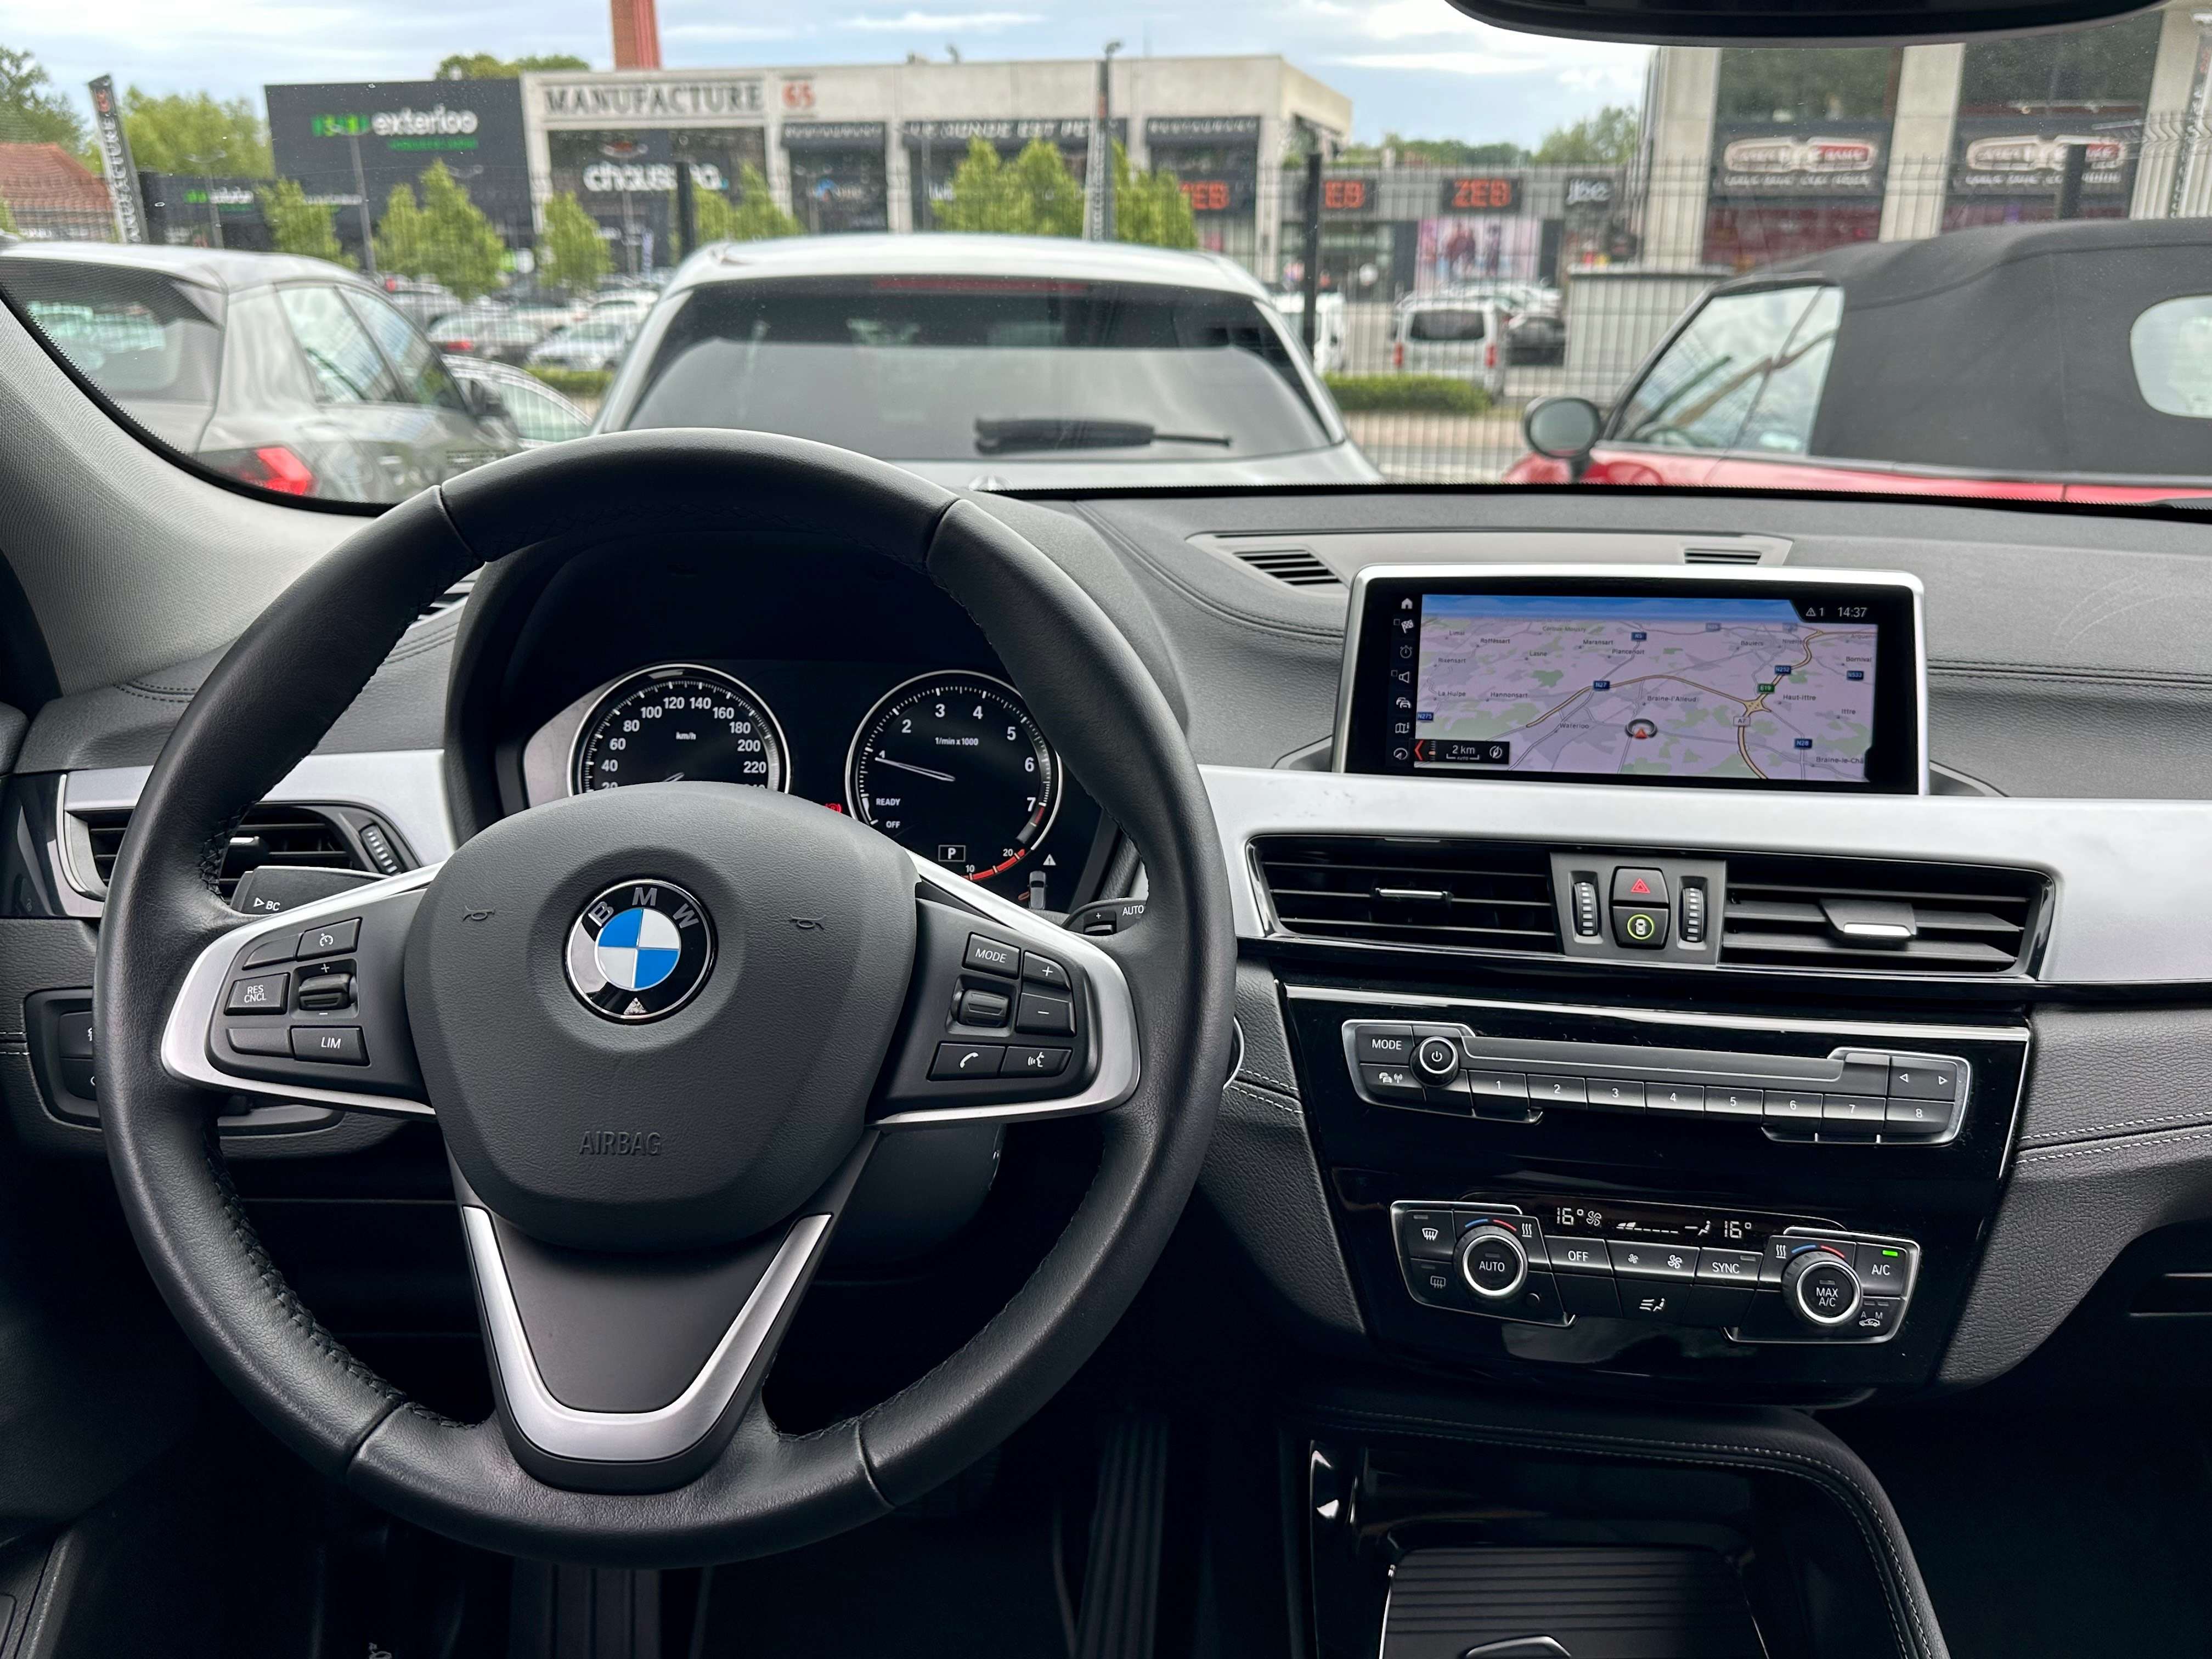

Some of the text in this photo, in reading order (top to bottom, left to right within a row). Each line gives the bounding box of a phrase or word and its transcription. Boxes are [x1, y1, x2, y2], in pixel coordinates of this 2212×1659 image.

[548, 84, 761, 112] MANUFACTURE
[782, 81, 815, 109] 65
[1452, 178, 1511, 208] ZEB
[1819, 607, 1824, 617] 1
[1838, 607, 1867, 618] 14:37
[663, 697, 685, 709] 120
[690, 697, 712, 709] 140
[640, 706, 662, 719] 100
[713, 707, 735, 719] 160
[935, 704, 945, 718] 3
[973, 706, 983, 719] 4
[623, 720, 640, 732] 80
[729, 721, 751, 734] 180
[901, 719, 912, 733] 2
[675, 731, 697, 741] km/h
[1006, 726, 1017, 741] 5
[610, 737, 627, 751] 60
[737, 740, 761, 752] 200
[935, 737, 955, 746] 1/min
[961, 737, 979, 746] 1000
[1452, 744, 1475, 754] 2 km
[601, 759, 618, 772] 40
[743, 761, 766, 774] 220
[1024, 757, 1035, 772] 6
[876, 798, 901, 806] READY
[1026, 797, 1036, 812] 7
[947, 848, 957, 860] P
[1002, 848, 1013, 857] 20
[966, 865, 975, 873] 10
[265, 900, 281, 912] BC
[588, 887, 700, 929] BMW
[1122, 905, 1144, 917] AUTO
[975, 948, 1007, 963] MODE
[247, 984, 264, 994] RES
[244, 991, 267, 1002] CNCL
[320, 1036, 342, 1049] LIM
[1372, 1038, 1402, 1051] MODE
[1495, 1080, 1501, 1091] 1
[1554, 1084, 1561, 1094] 2
[1612, 1088, 1619, 1098] 3
[1669, 1092, 1677, 1102] 4
[1730, 1096, 1736, 1107] 5
[1789, 1099, 1797, 1110] 6
[1849, 1103, 1856, 1114] 7
[1915, 1108, 1923, 1119] 8
[579, 1131, 662, 1156] AIRBAG
[1567, 1250, 1588, 1262] OFF
[1479, 1261, 1505, 1272] AUTO
[1712, 1262, 1740, 1274] SYNC
[1871, 1263, 1891, 1276] A/C
[1816, 1288, 1838, 1297] MAX
[1819, 1296, 1836, 1308] A/C
[1875, 1311, 1883, 1319] M
